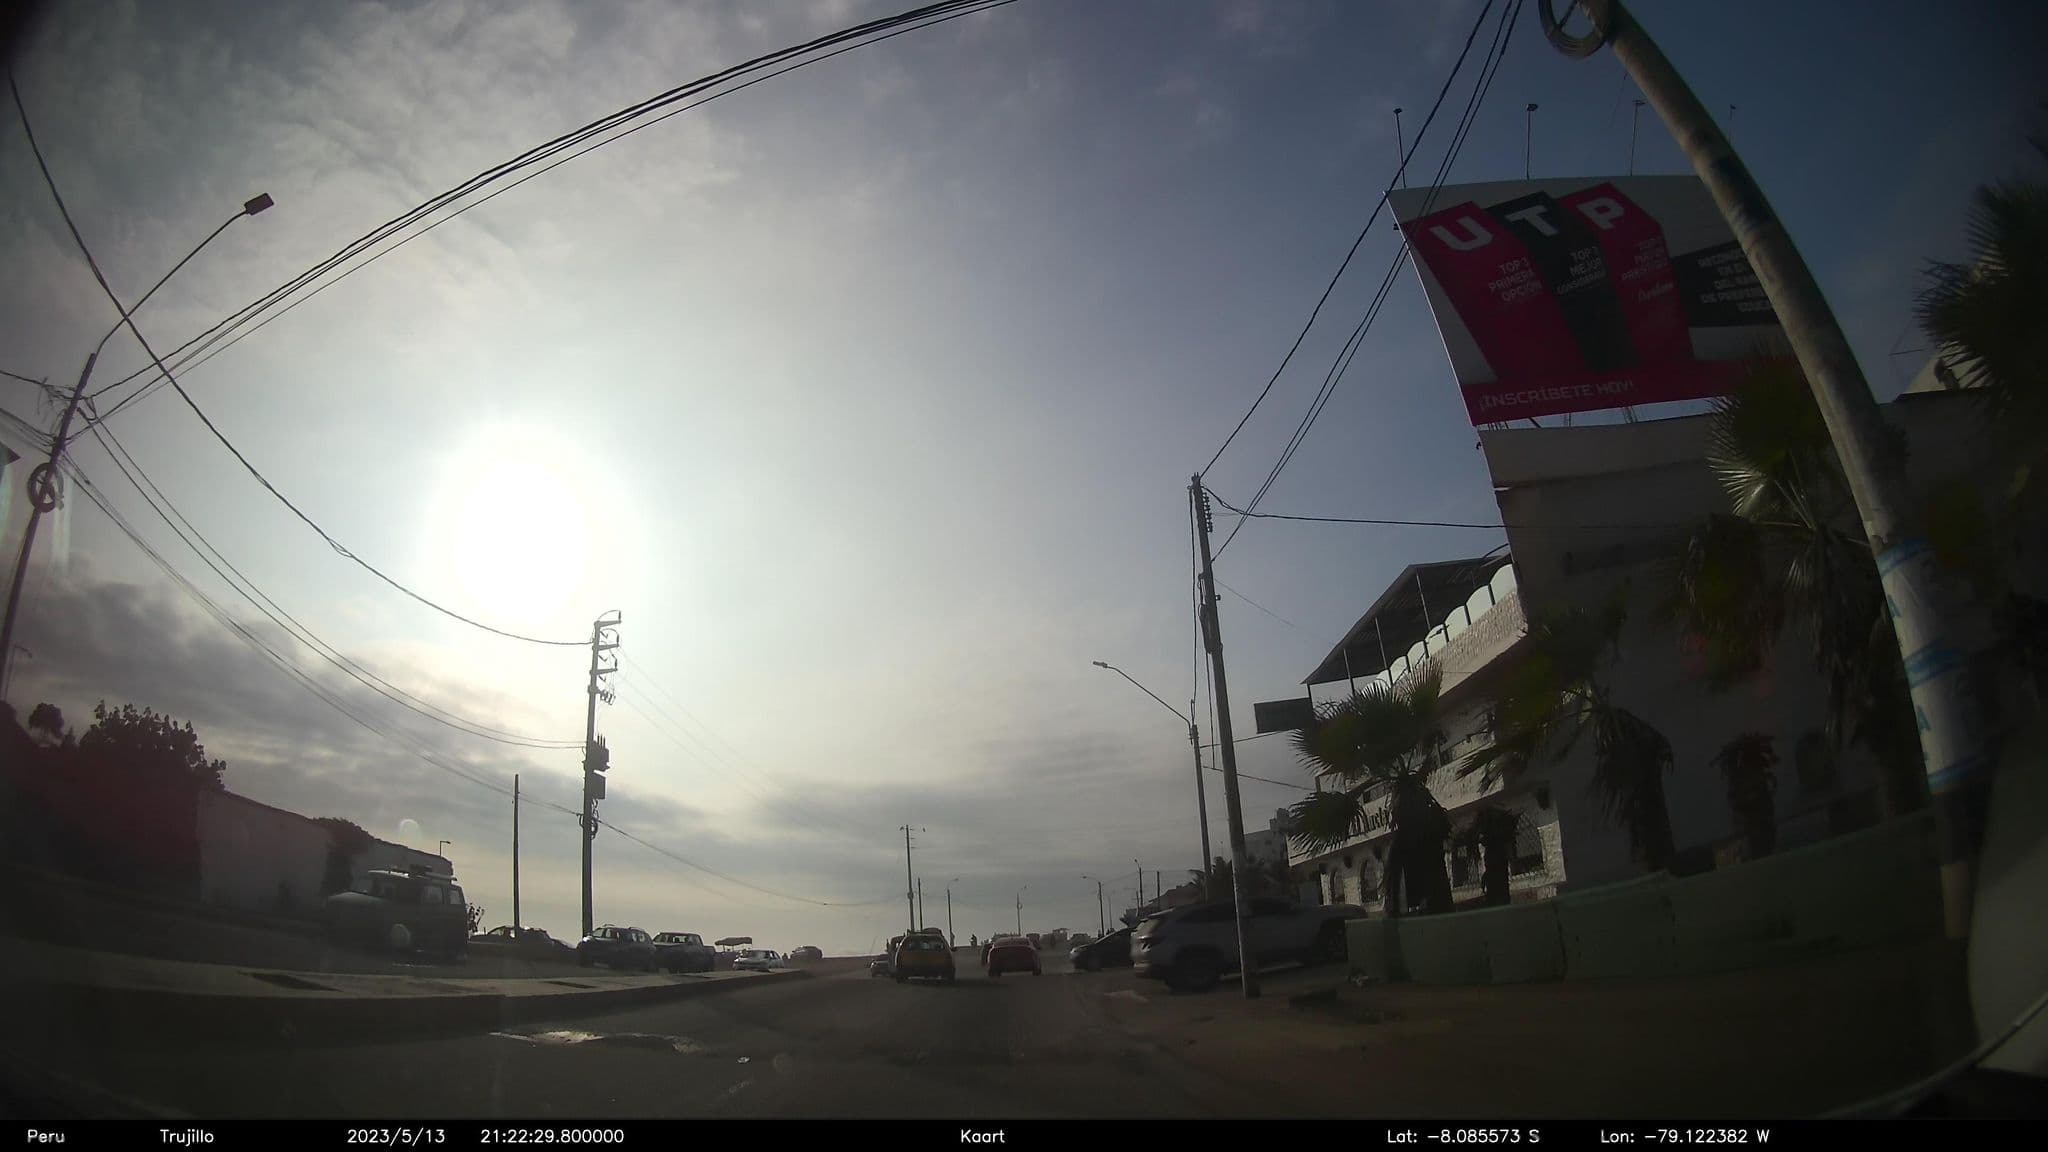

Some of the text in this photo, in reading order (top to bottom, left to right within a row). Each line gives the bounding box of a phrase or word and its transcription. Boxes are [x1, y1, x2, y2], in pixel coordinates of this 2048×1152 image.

[1570, 247, 1592, 262] TOP
[1497, 260, 1521, 275] TOP
[1487, 268, 1536, 295] PRIMERA
